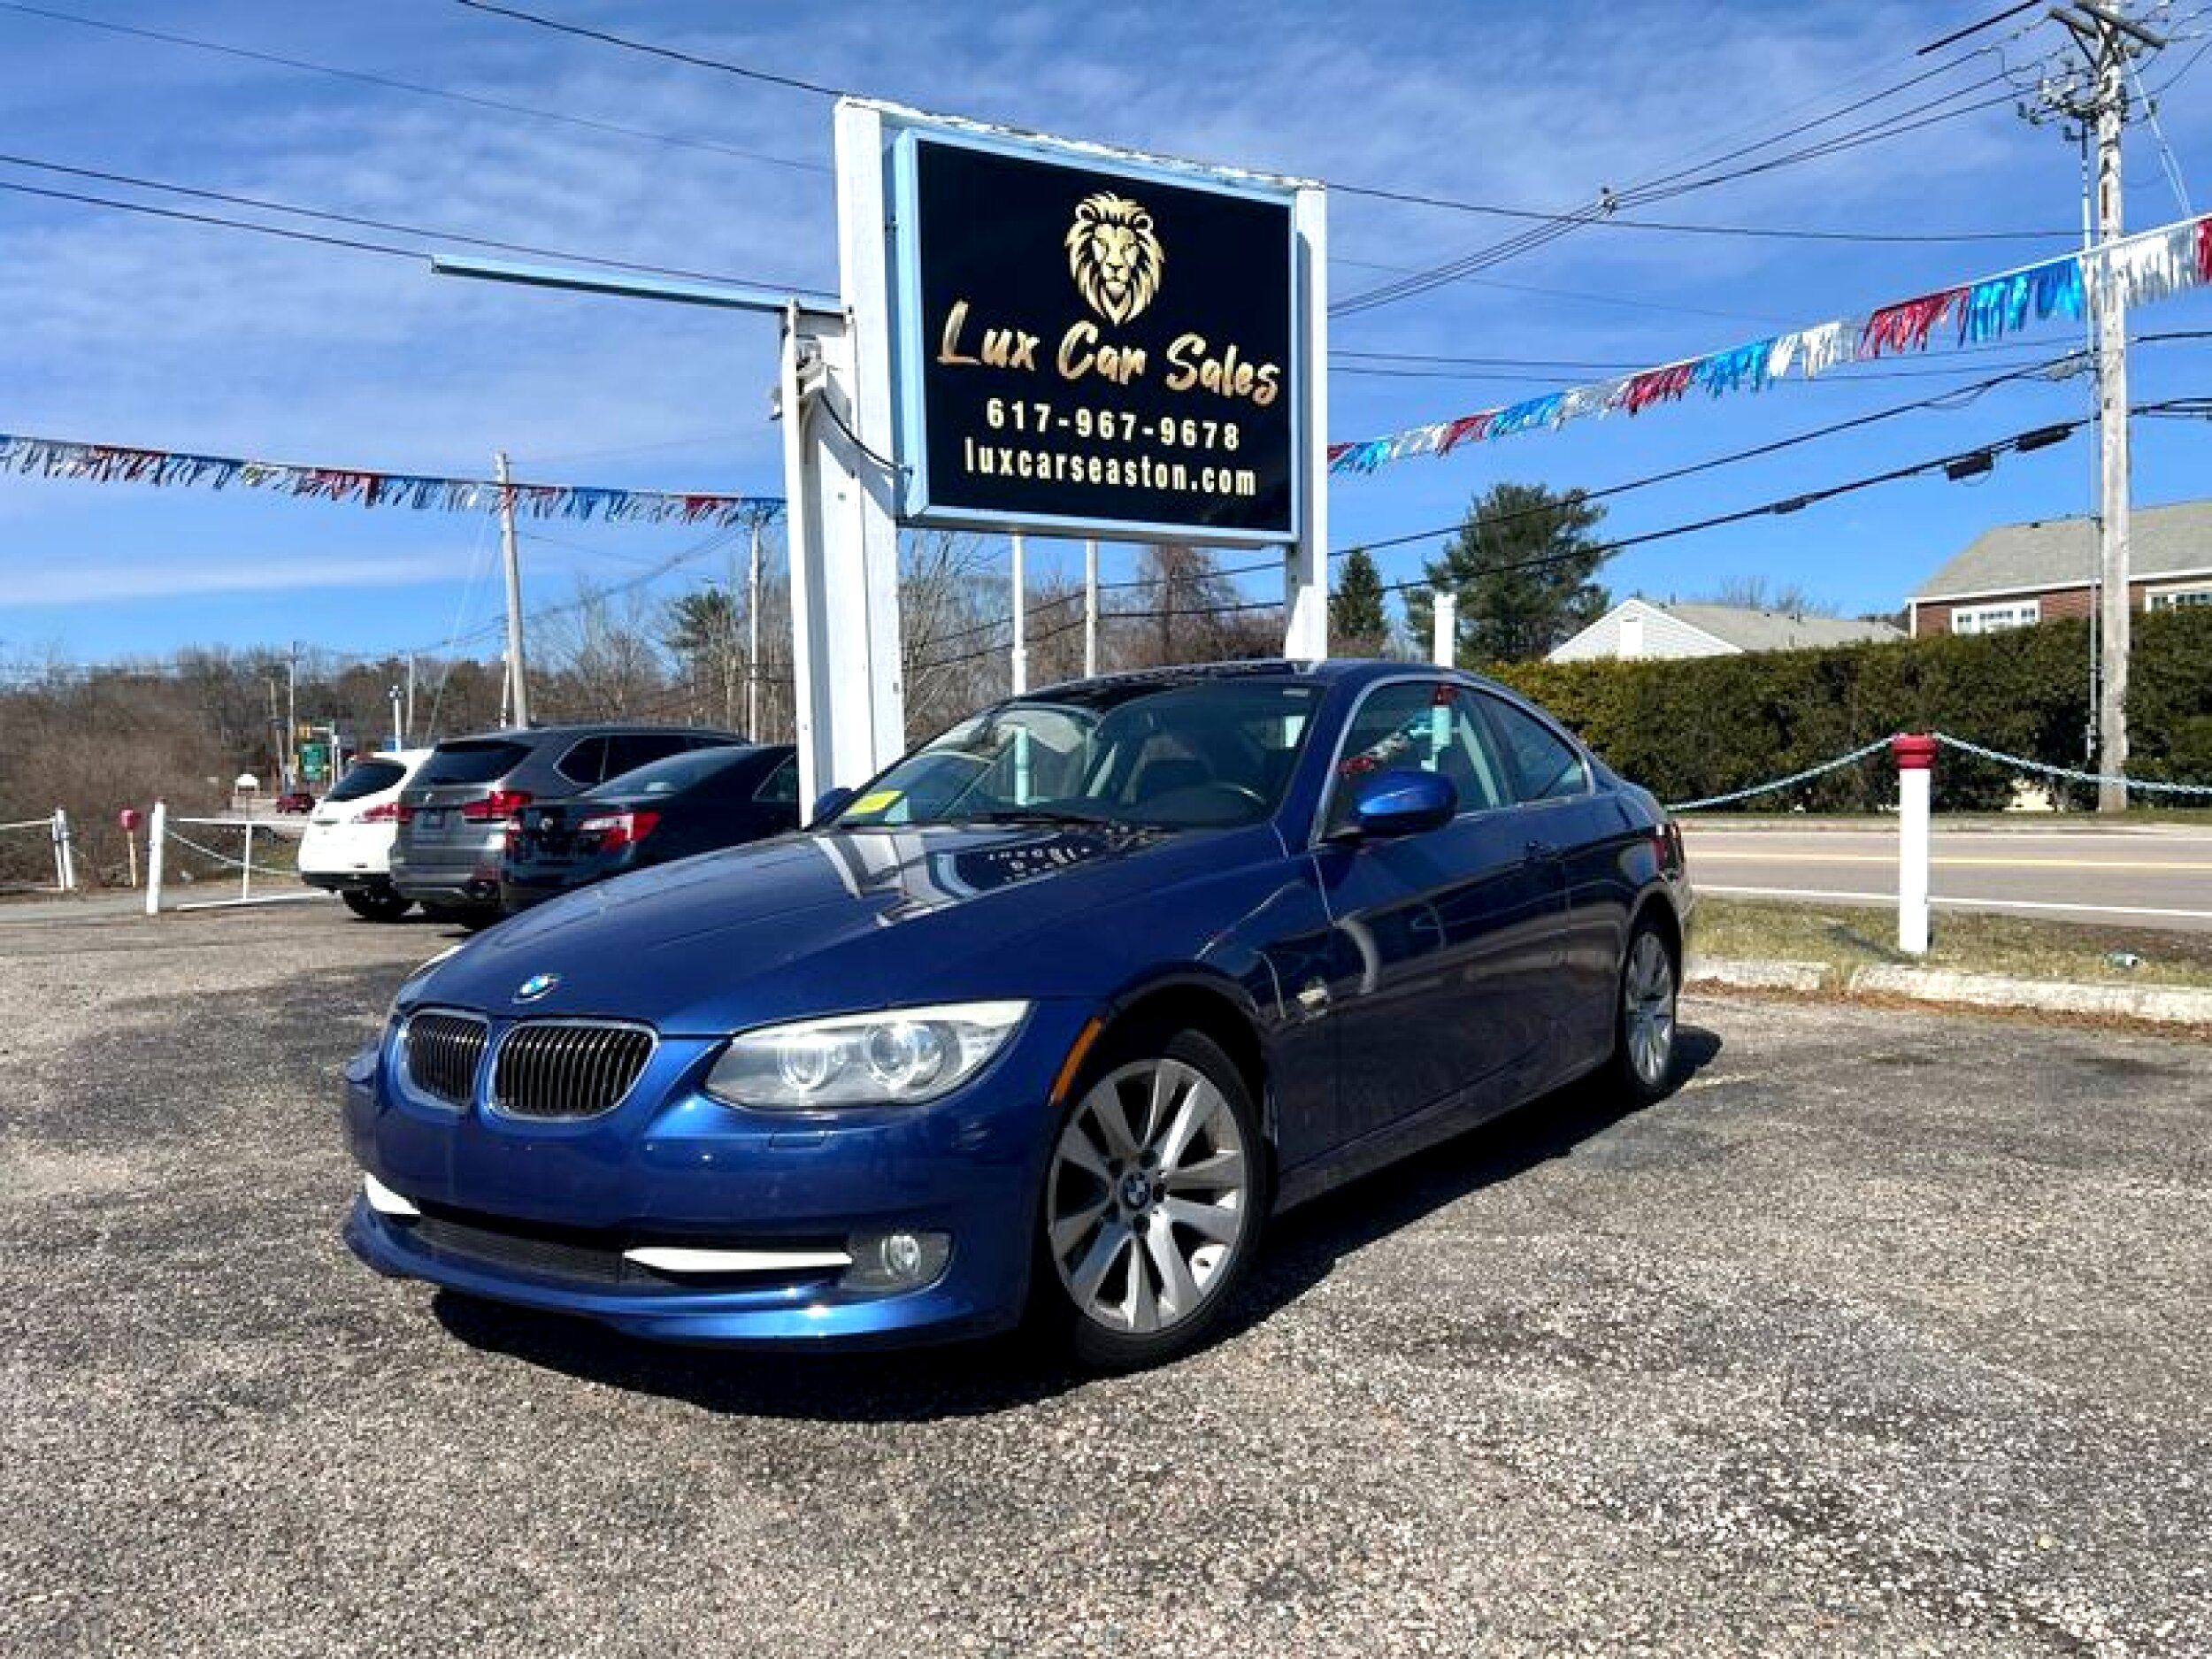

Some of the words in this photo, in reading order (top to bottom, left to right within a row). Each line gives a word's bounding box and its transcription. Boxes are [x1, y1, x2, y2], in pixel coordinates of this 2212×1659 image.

[936, 300, 1041, 372] Lux
[1057, 319, 1148, 385] Car
[1165, 333, 1281, 405] Sales
[987, 397, 1240, 451] 617-967-9678
[964, 437, 1256, 496] luxcarseaston.com
